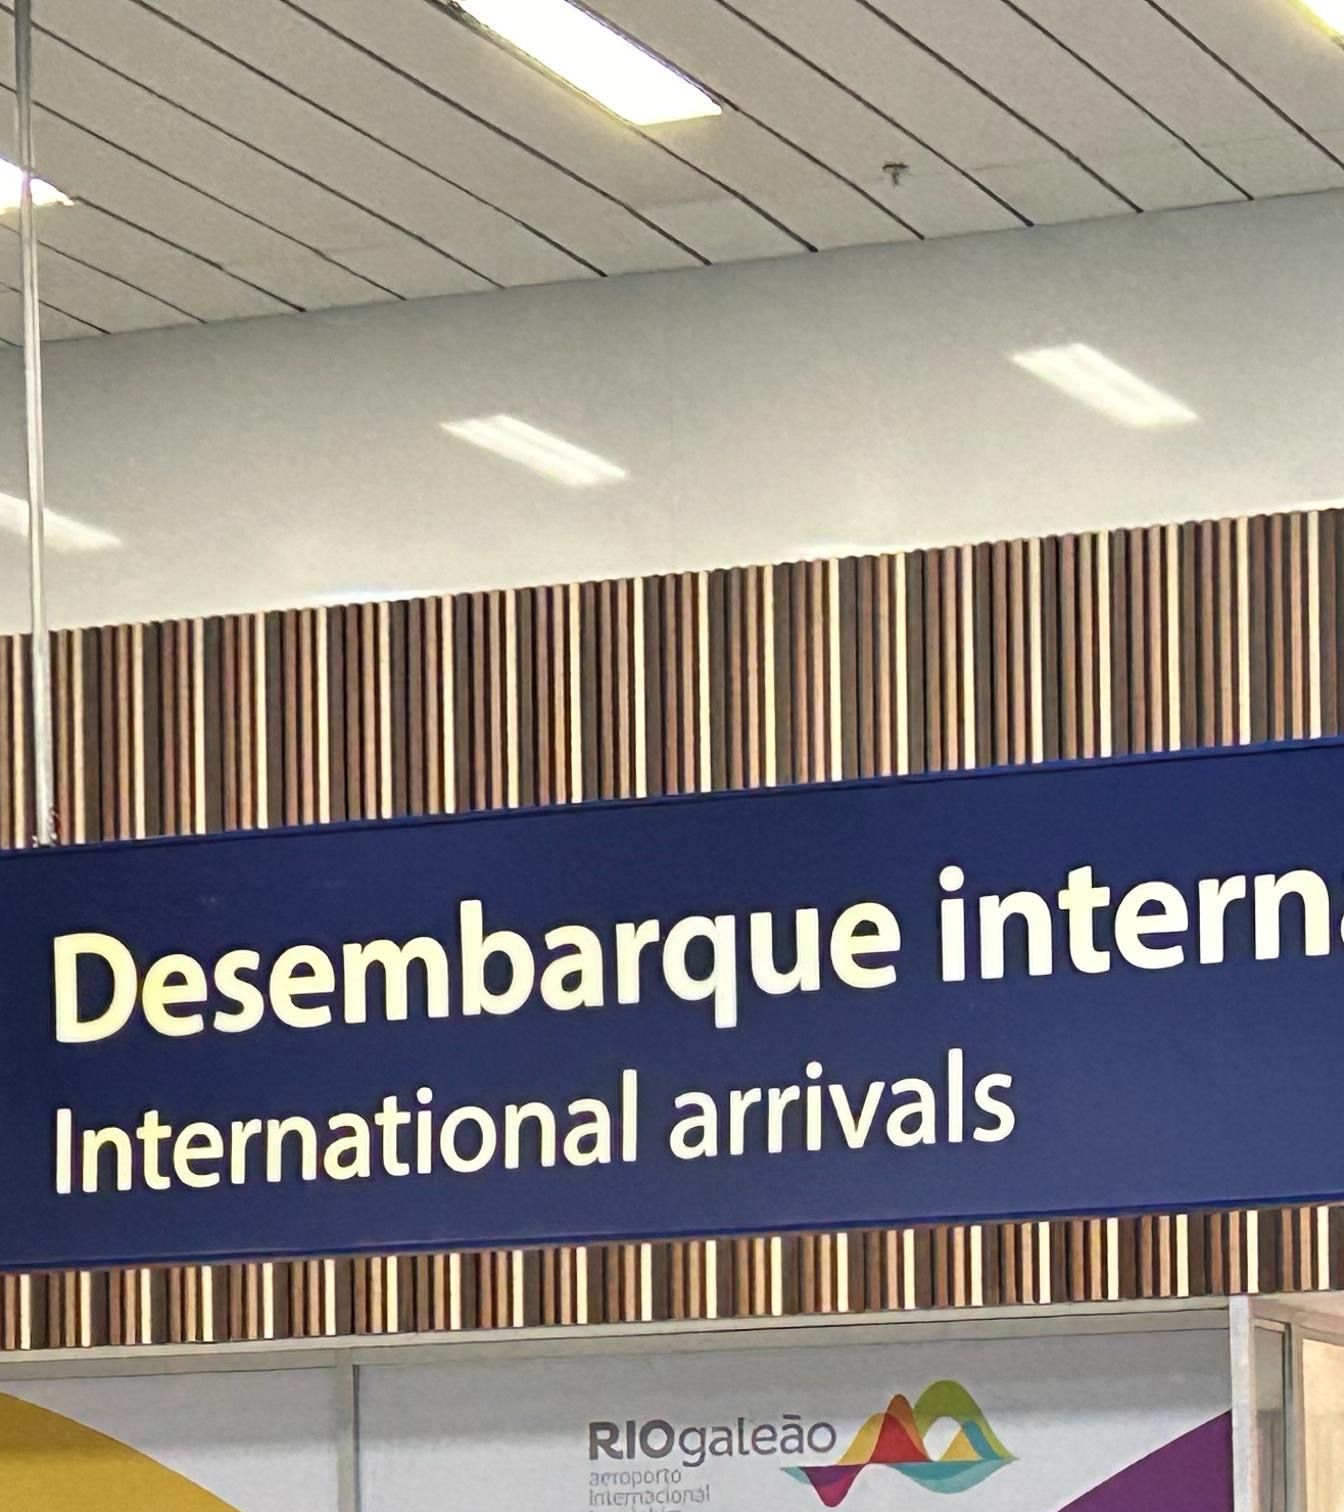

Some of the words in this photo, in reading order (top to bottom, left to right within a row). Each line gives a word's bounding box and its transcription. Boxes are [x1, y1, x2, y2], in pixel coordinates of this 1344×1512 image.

[54, 898, 902, 1043] Desembarque
[54, 1069, 639, 1195] International
[669, 1049, 1016, 1162] arrivals
[589, 1414, 837, 1467] RIOgaleão
[589, 1468, 682, 1488] aeroporto
[589, 1485, 711, 1506] internacional
